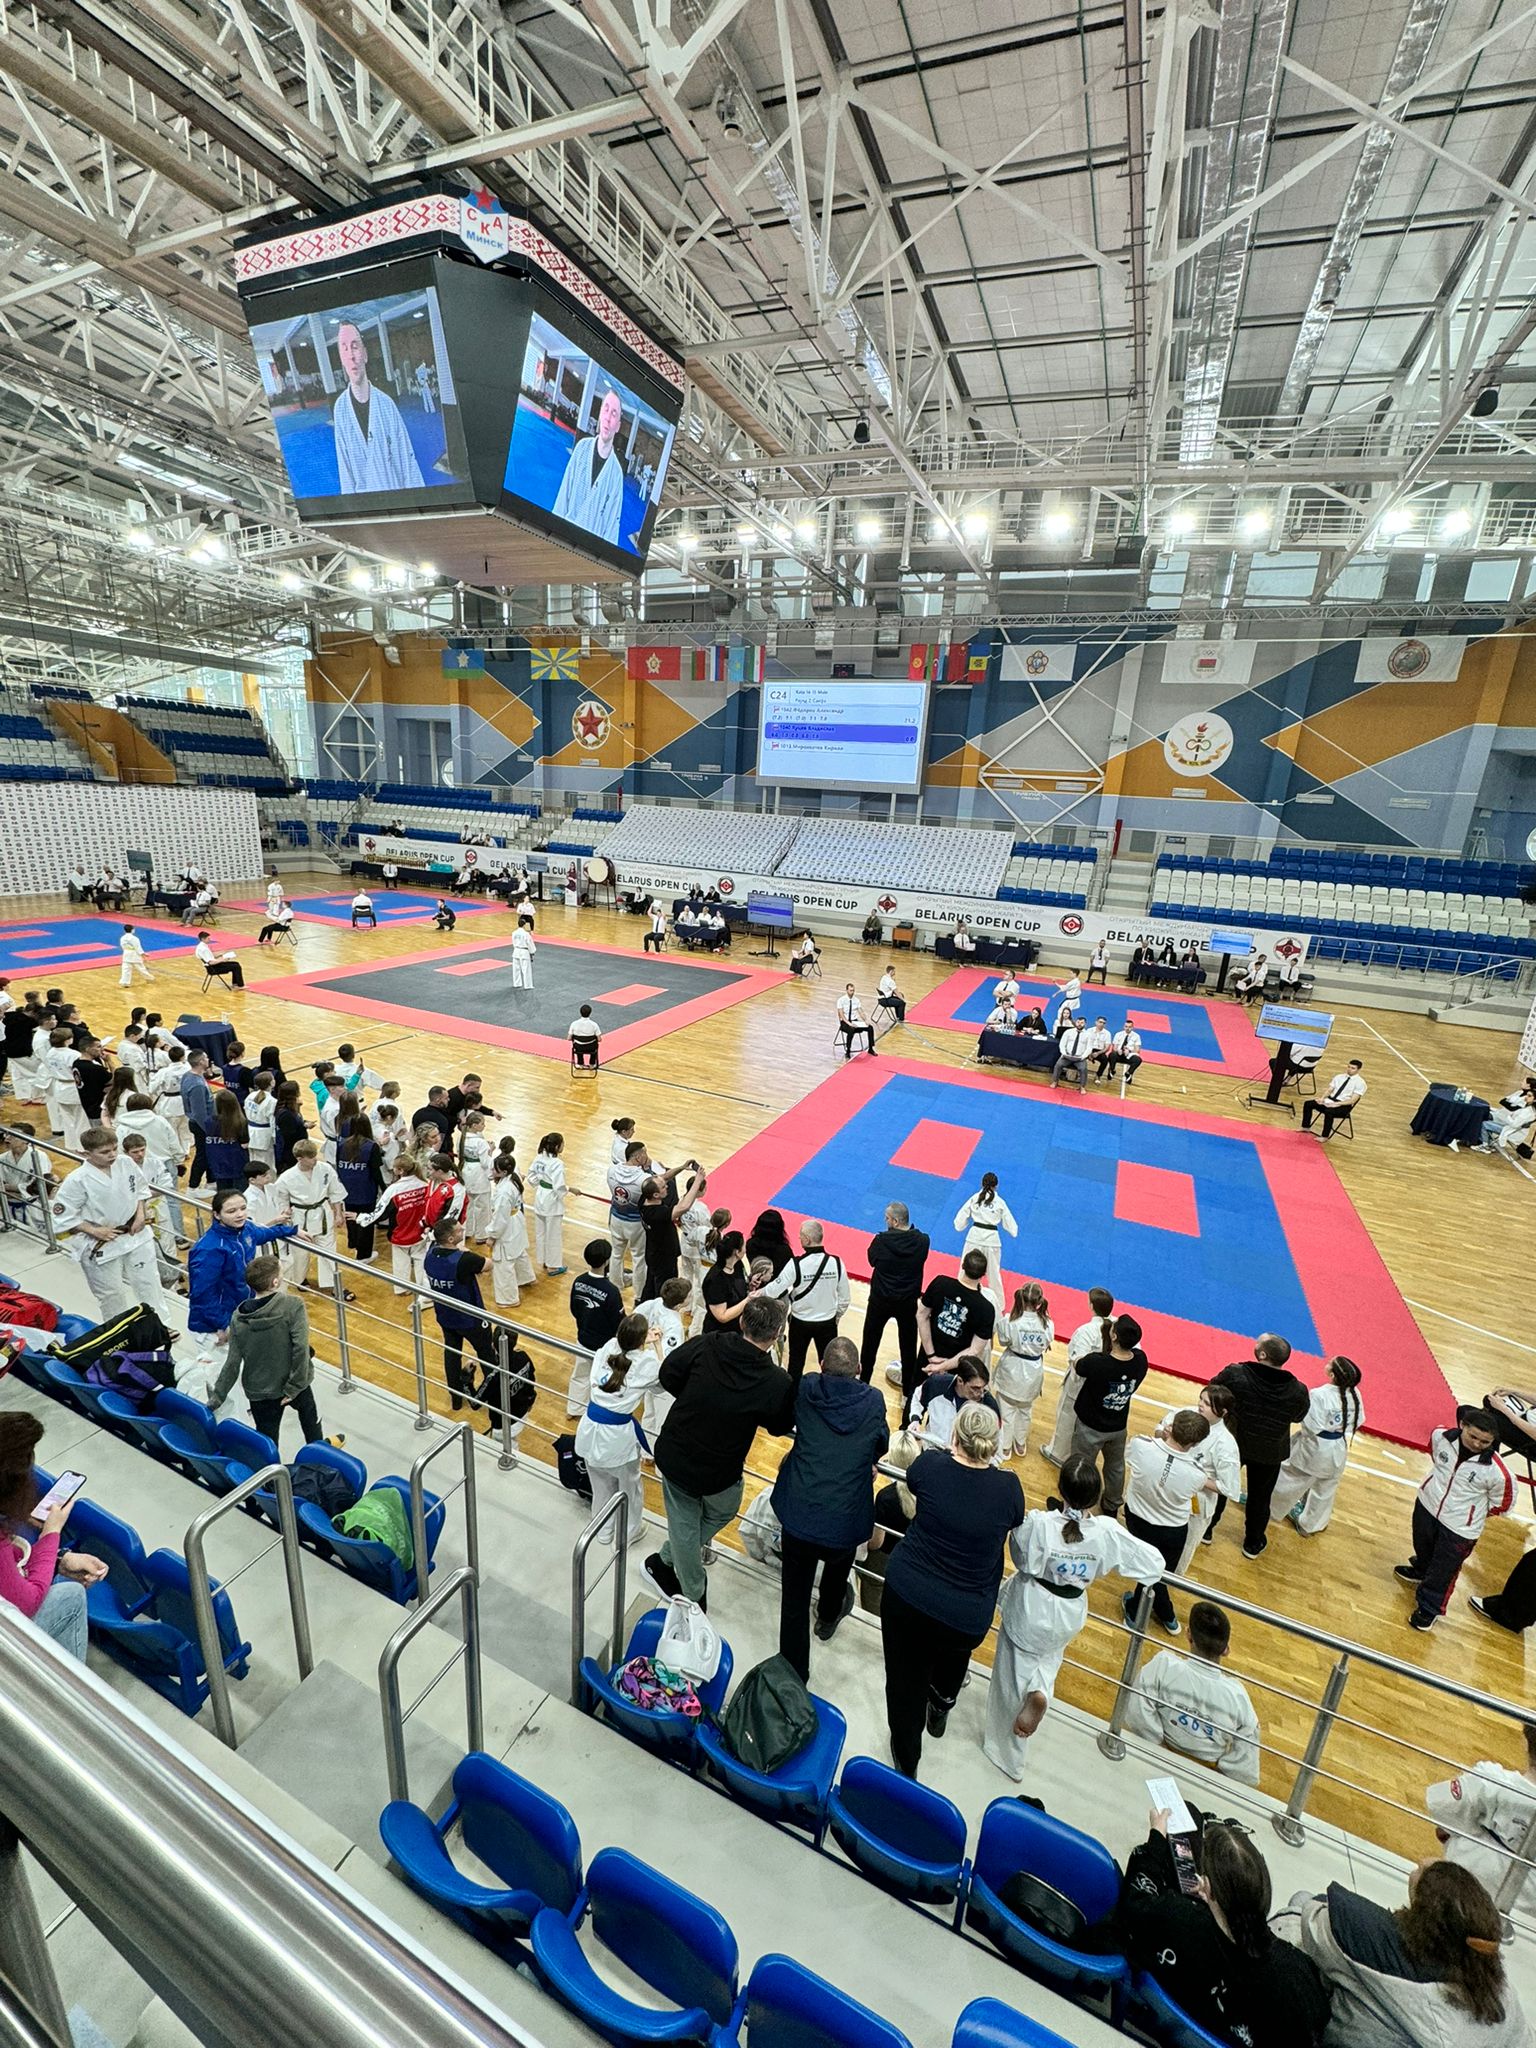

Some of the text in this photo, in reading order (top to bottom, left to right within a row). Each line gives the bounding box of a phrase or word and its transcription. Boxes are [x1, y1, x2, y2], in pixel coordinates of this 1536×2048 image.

[466, 207, 503, 236] СКА
[440, 854, 456, 863] CUP
[615, 873, 653, 887] ELARUS
[654, 878, 680, 890] OPEN
[803, 895, 832, 908] OPEN
[835, 899, 859, 910] CUP
[915, 908, 1042, 932] BELARUS OPEN CUP
[1106, 930, 1175, 946] BELARUS
[1179, 938, 1210, 951] OPE
[338, 1160, 367, 1171] STAFF
[429, 1280, 455, 1289] TAFF
[1021, 1333, 1043, 1343] 696
[103, 1339, 129, 1356] SPORT
